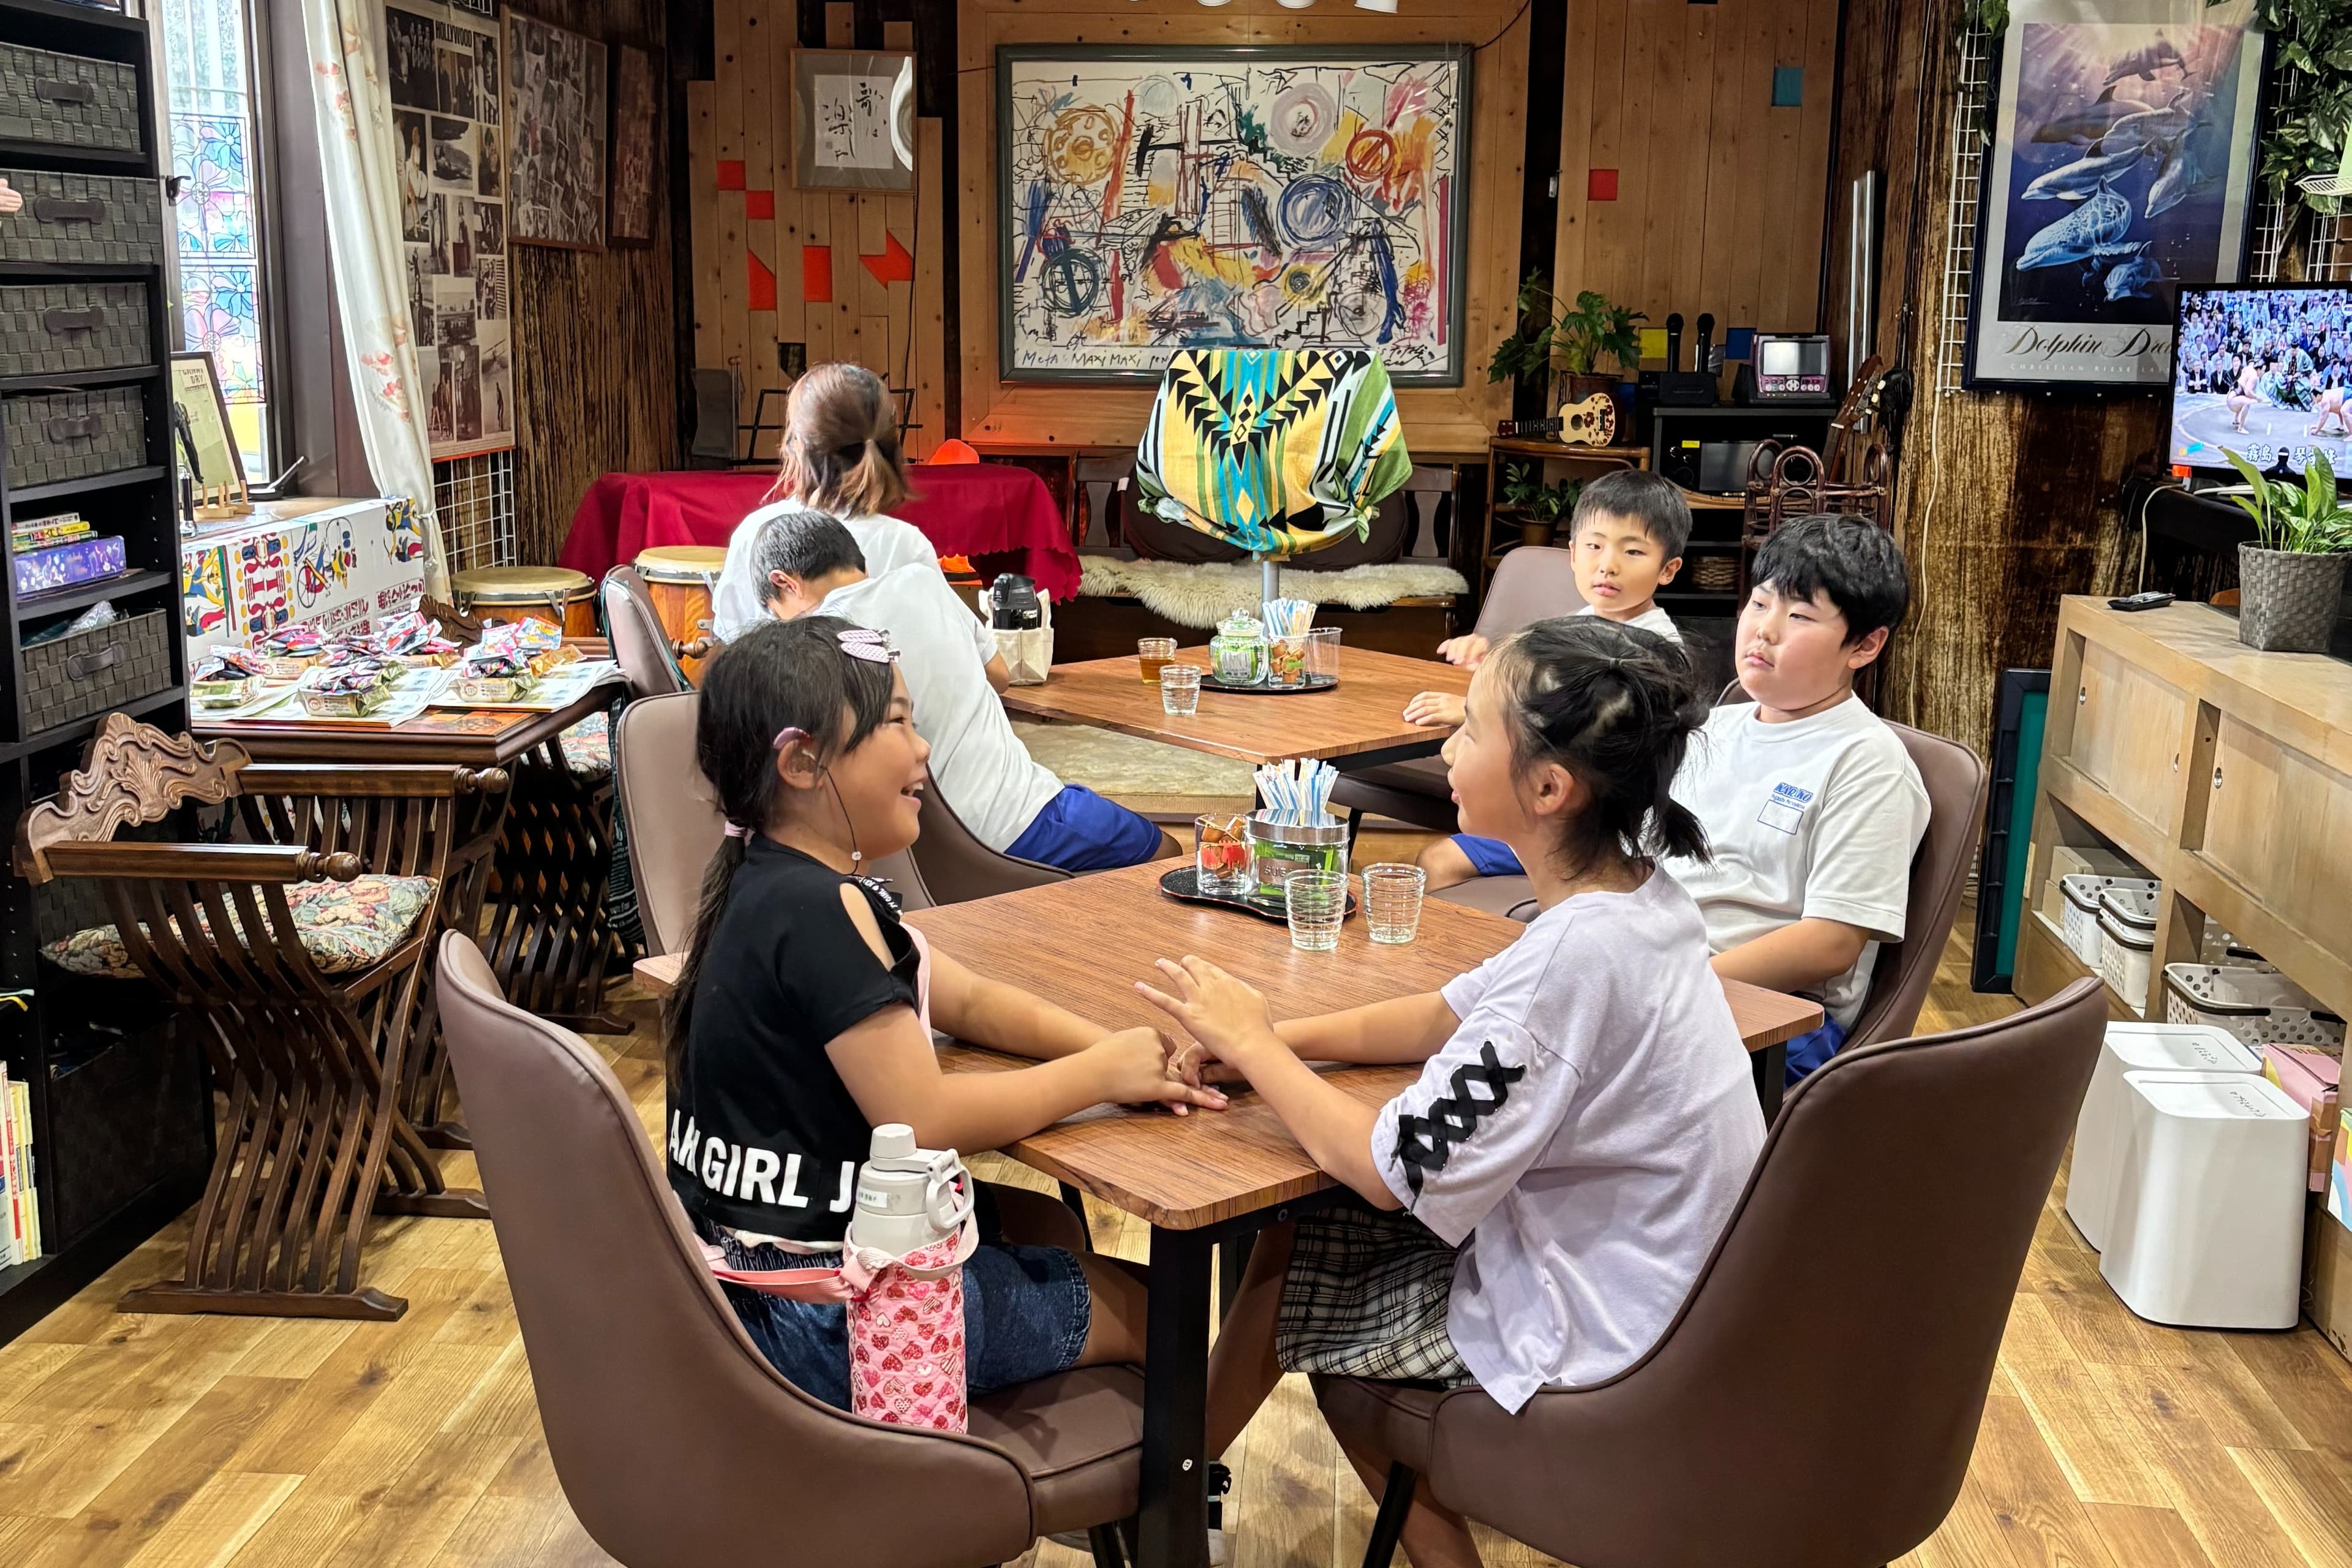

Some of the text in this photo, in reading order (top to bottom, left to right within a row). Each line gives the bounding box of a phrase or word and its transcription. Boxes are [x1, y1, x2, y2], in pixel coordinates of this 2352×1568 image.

[435, 20, 472, 47] HOLLYWOOD
[2195, 297, 2220, 311] 5:37
[2005, 326, 2102, 361] Dolphin
[702, 1136, 809, 1208] GIRL
